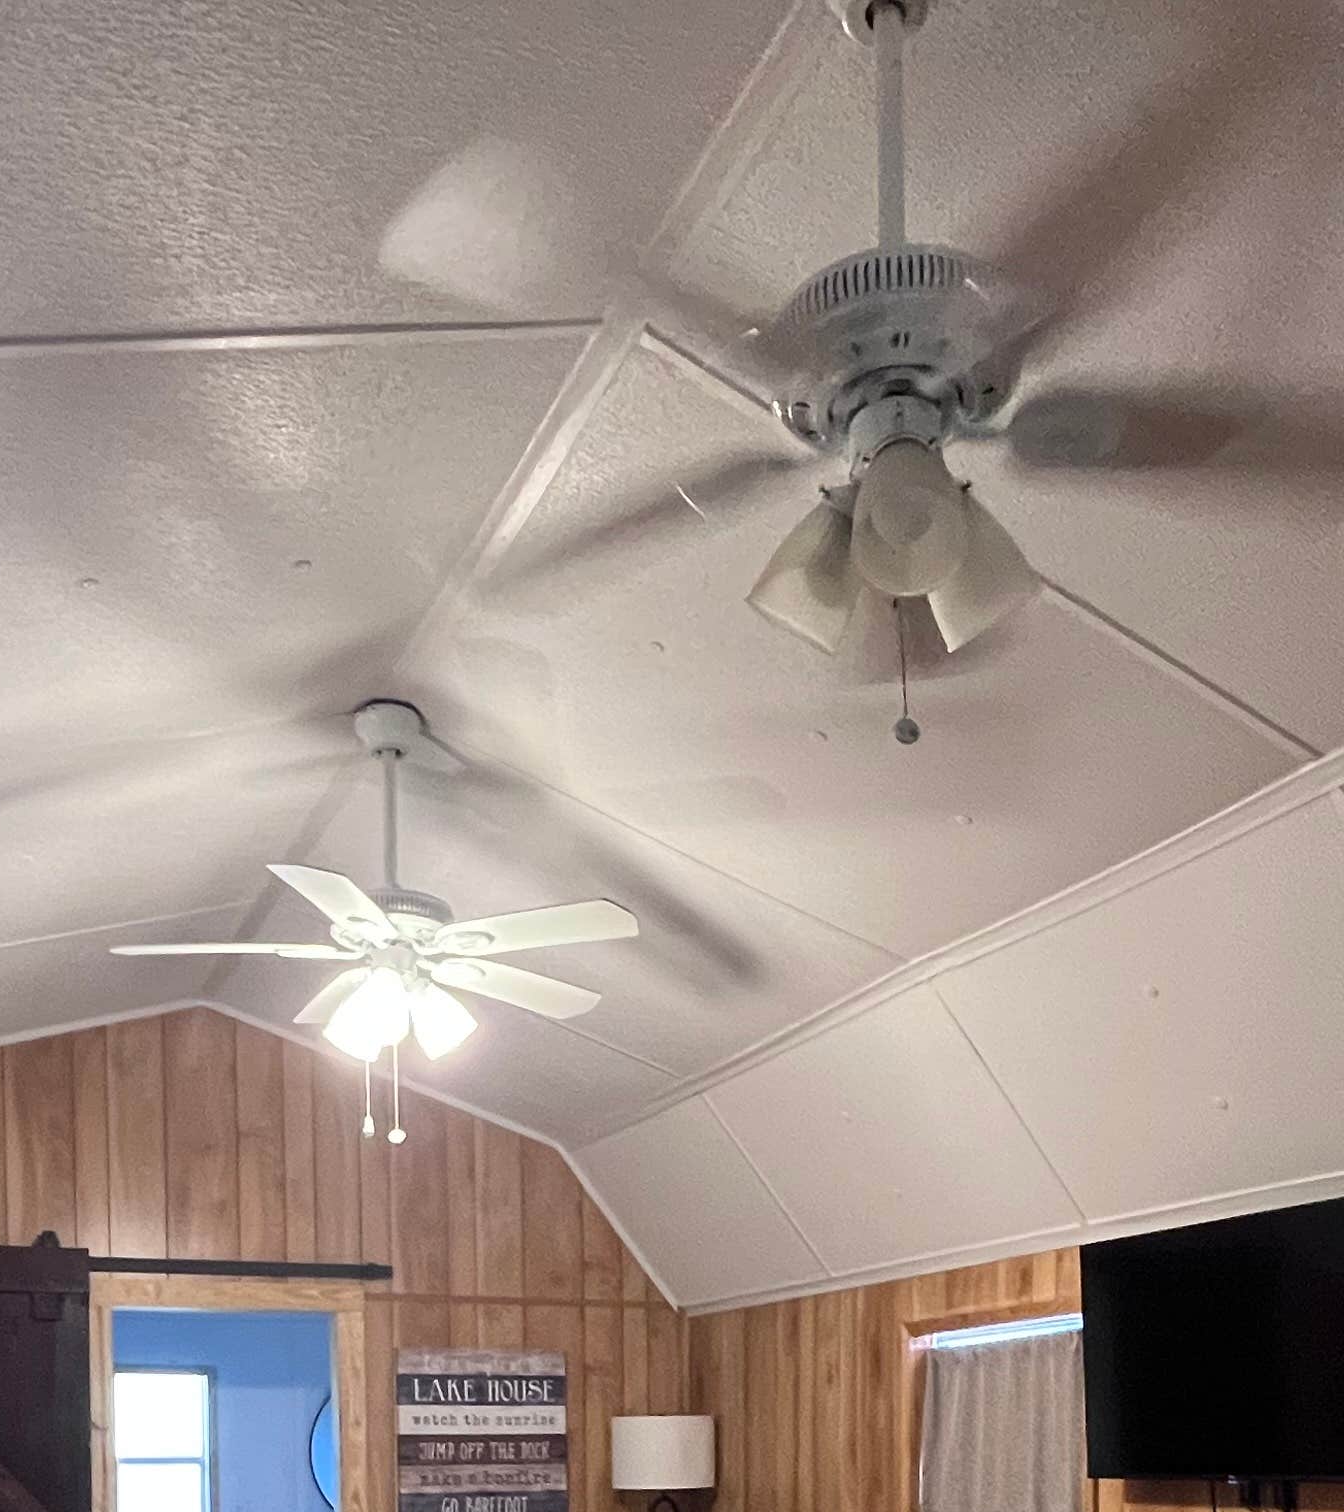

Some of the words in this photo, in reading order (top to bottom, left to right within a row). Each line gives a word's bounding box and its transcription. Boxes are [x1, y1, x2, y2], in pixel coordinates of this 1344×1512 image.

[413, 1378, 476, 1402] LAKE
[488, 1379, 555, 1402] HOUSE
[412, 1414, 458, 1426] watch
[464, 1414, 491, 1426] the
[495, 1413, 556, 1426] sunrise
[418, 1442, 455, 1460] JUMP
[459, 1441, 484, 1460] OFF
[489, 1441, 515, 1460] THE
[519, 1440, 551, 1460] DOCK
[482, 1469, 552, 1486] bonfire
